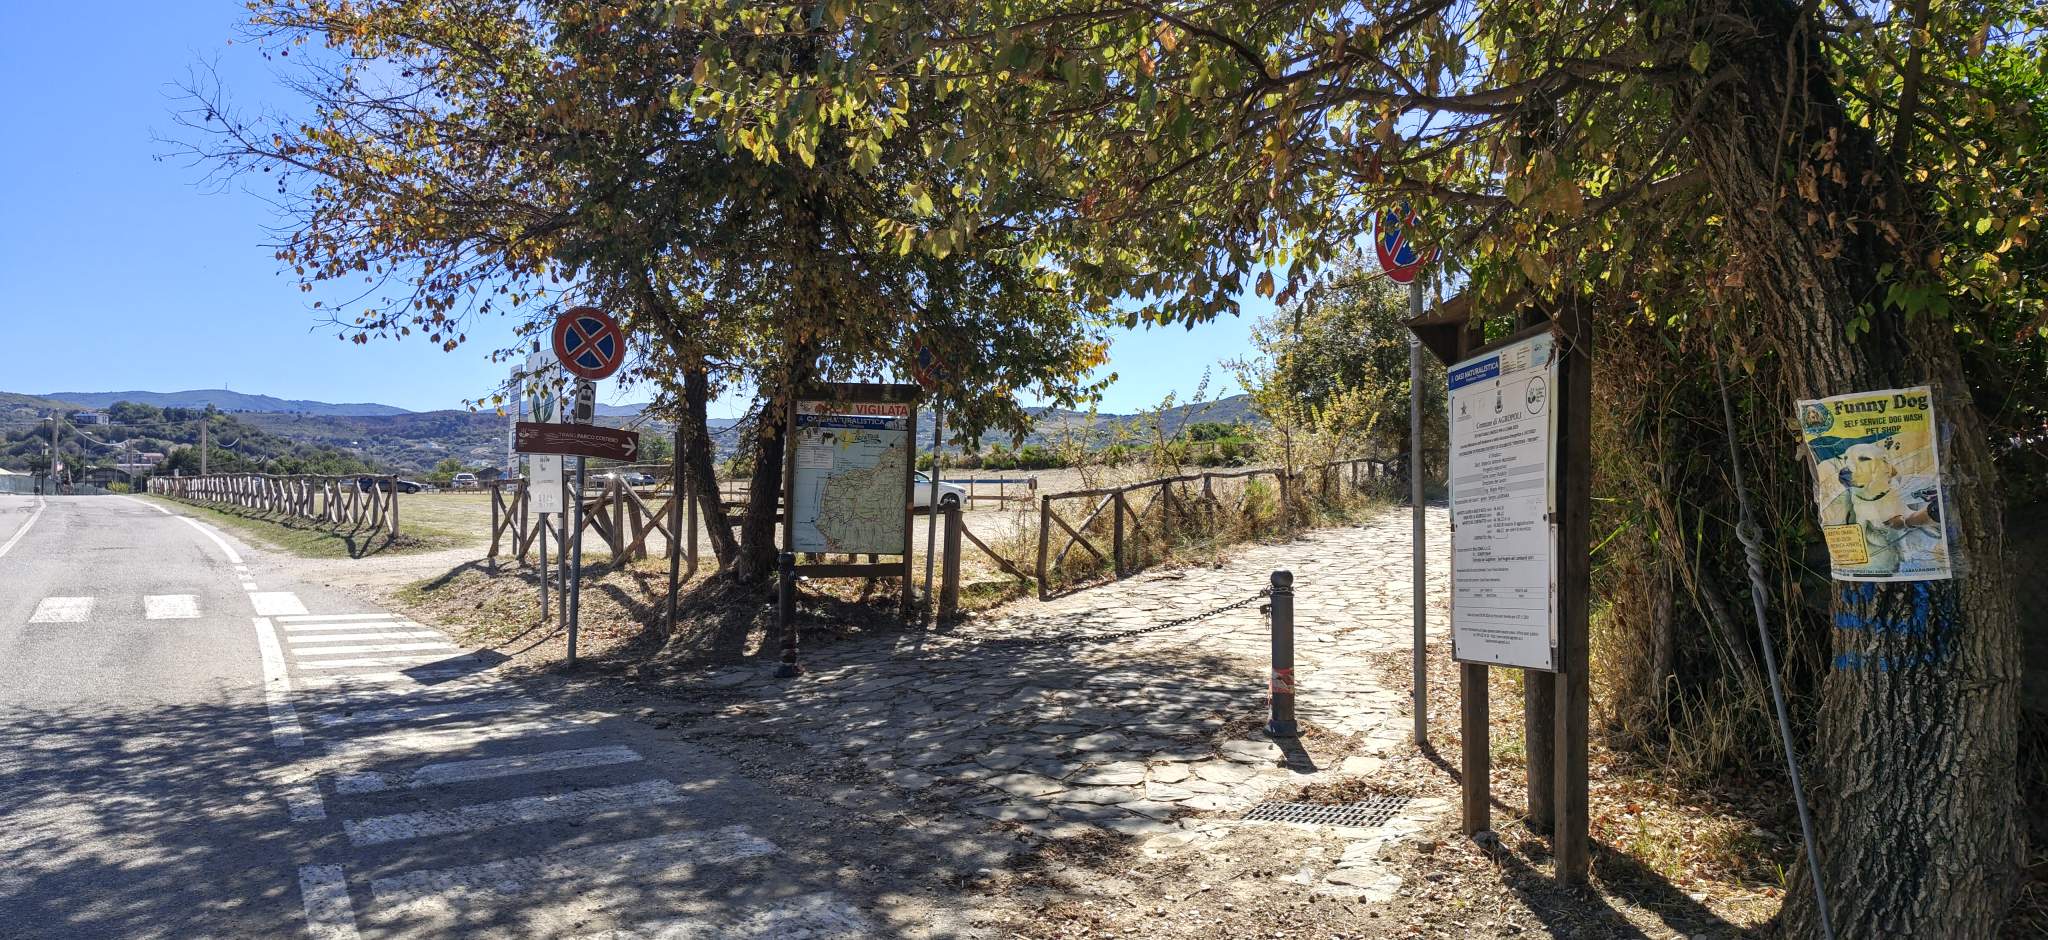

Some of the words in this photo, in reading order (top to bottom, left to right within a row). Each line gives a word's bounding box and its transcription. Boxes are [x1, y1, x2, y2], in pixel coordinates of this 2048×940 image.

[1465, 361, 1499, 378] NATURALISTICA
[855, 404, 908, 416] VIGILATA
[1833, 398, 1888, 415] Funny
[1892, 394, 1929, 410] Dog
[1843, 419, 1859, 428] SELF
[1860, 416, 1887, 426] SERVICE
[1889, 415, 1902, 425] DOG
[1904, 413, 1923, 422] WASH
[1866, 426, 1879, 435] PET
[1881, 425, 1902, 433] SHOP
